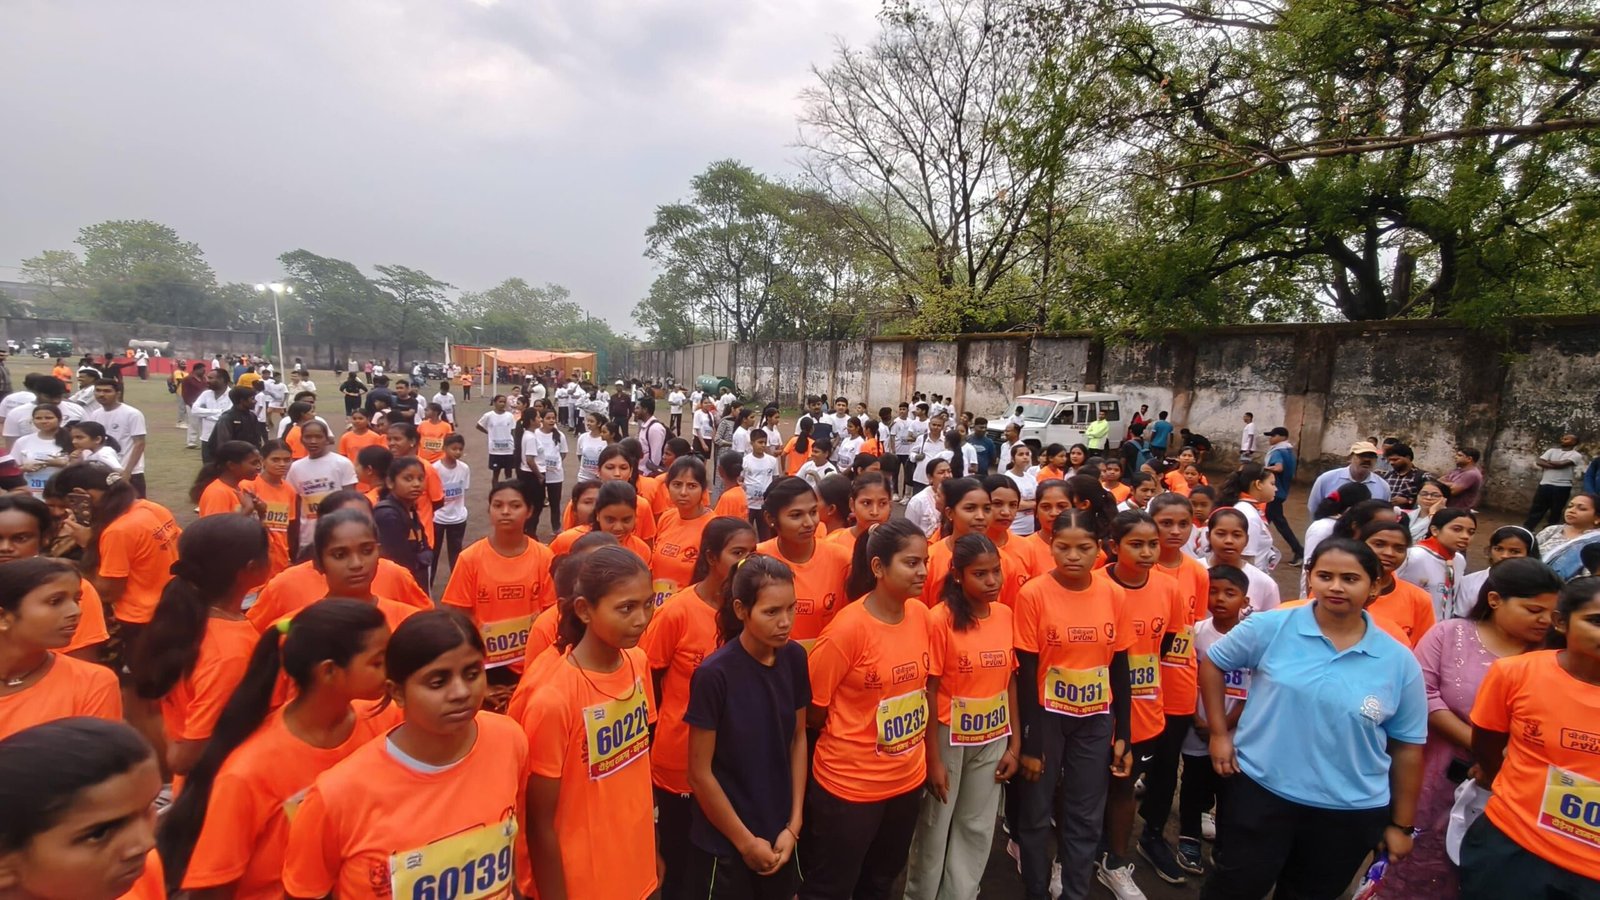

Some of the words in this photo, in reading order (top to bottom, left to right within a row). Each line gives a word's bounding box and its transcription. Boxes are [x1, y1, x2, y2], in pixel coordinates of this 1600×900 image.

[265, 510, 289, 523] 0125
[486, 627, 532, 653] 6026
[1054, 679, 1103, 703] 60131
[884, 704, 925, 742] 60232
[960, 704, 1006, 732] 60130
[412, 844, 511, 900] 60139
